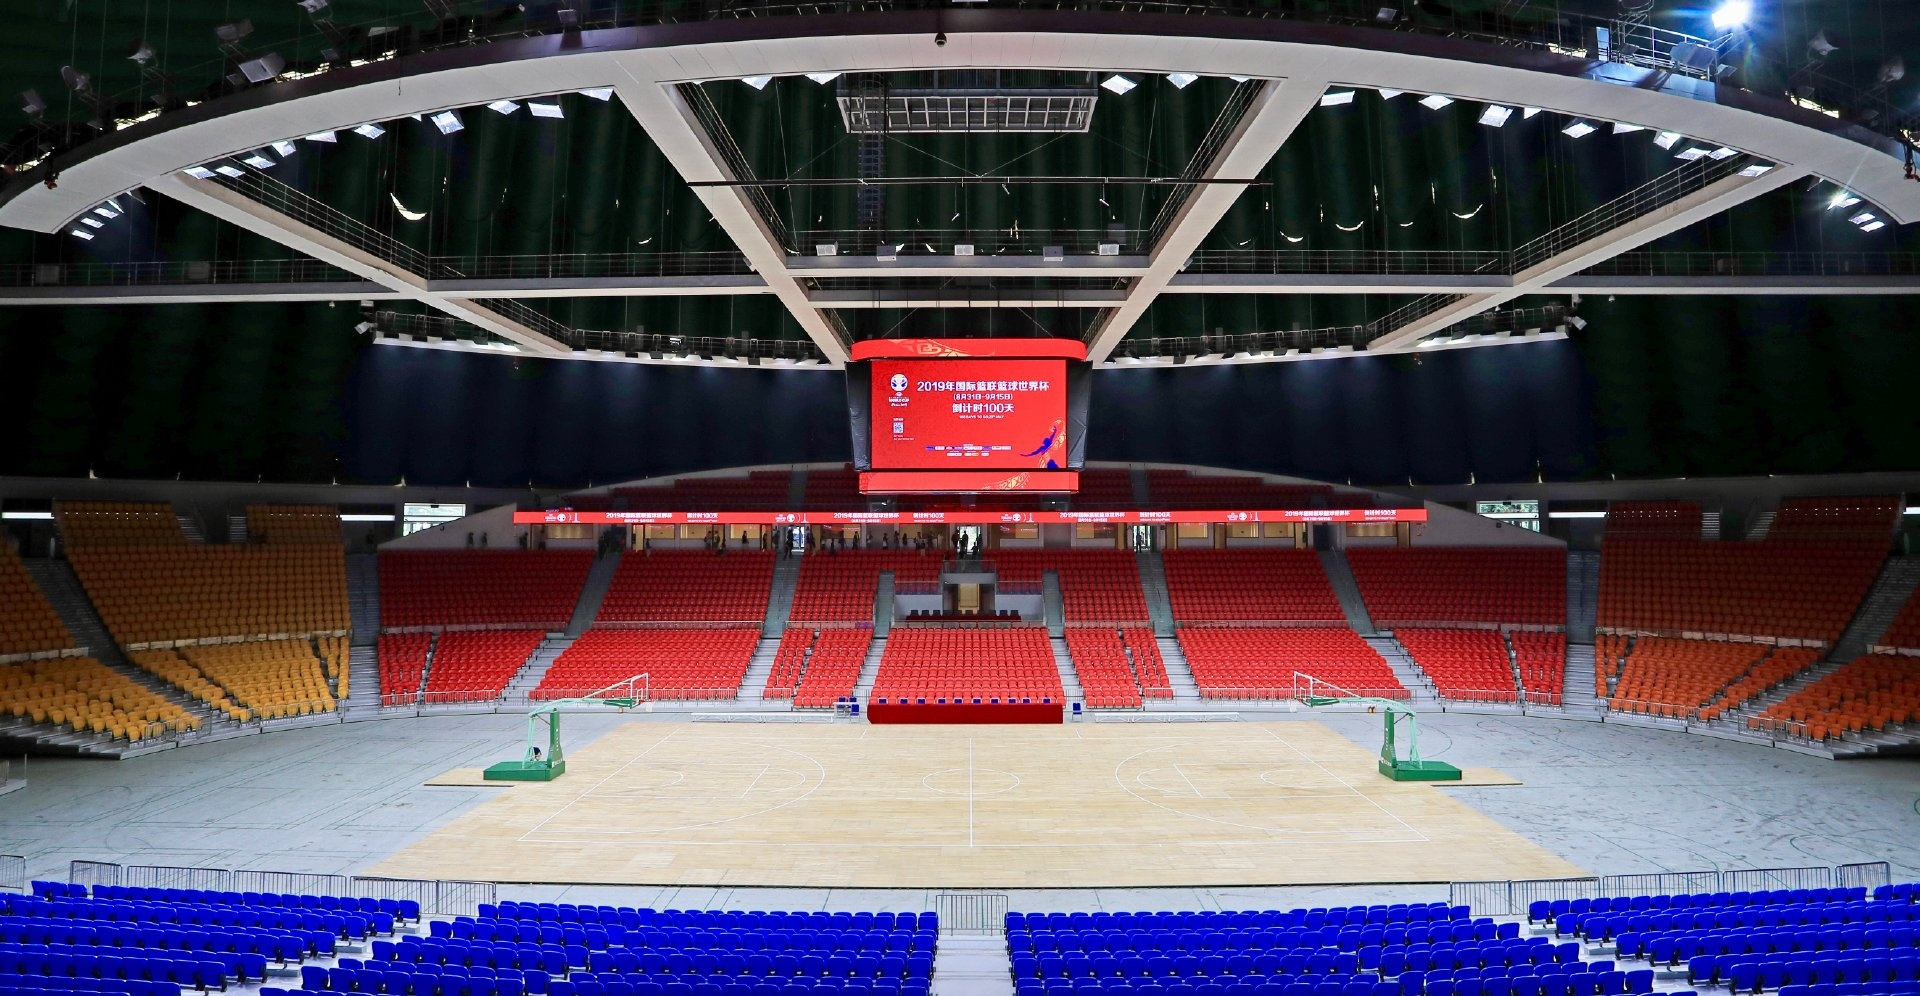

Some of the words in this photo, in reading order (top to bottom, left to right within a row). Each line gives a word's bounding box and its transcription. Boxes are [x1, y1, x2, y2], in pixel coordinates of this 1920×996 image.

[917, 381, 1050, 392] 2019年国际篮联篮球世界杯
[952, 403, 1015, 414] 倒计时100天
